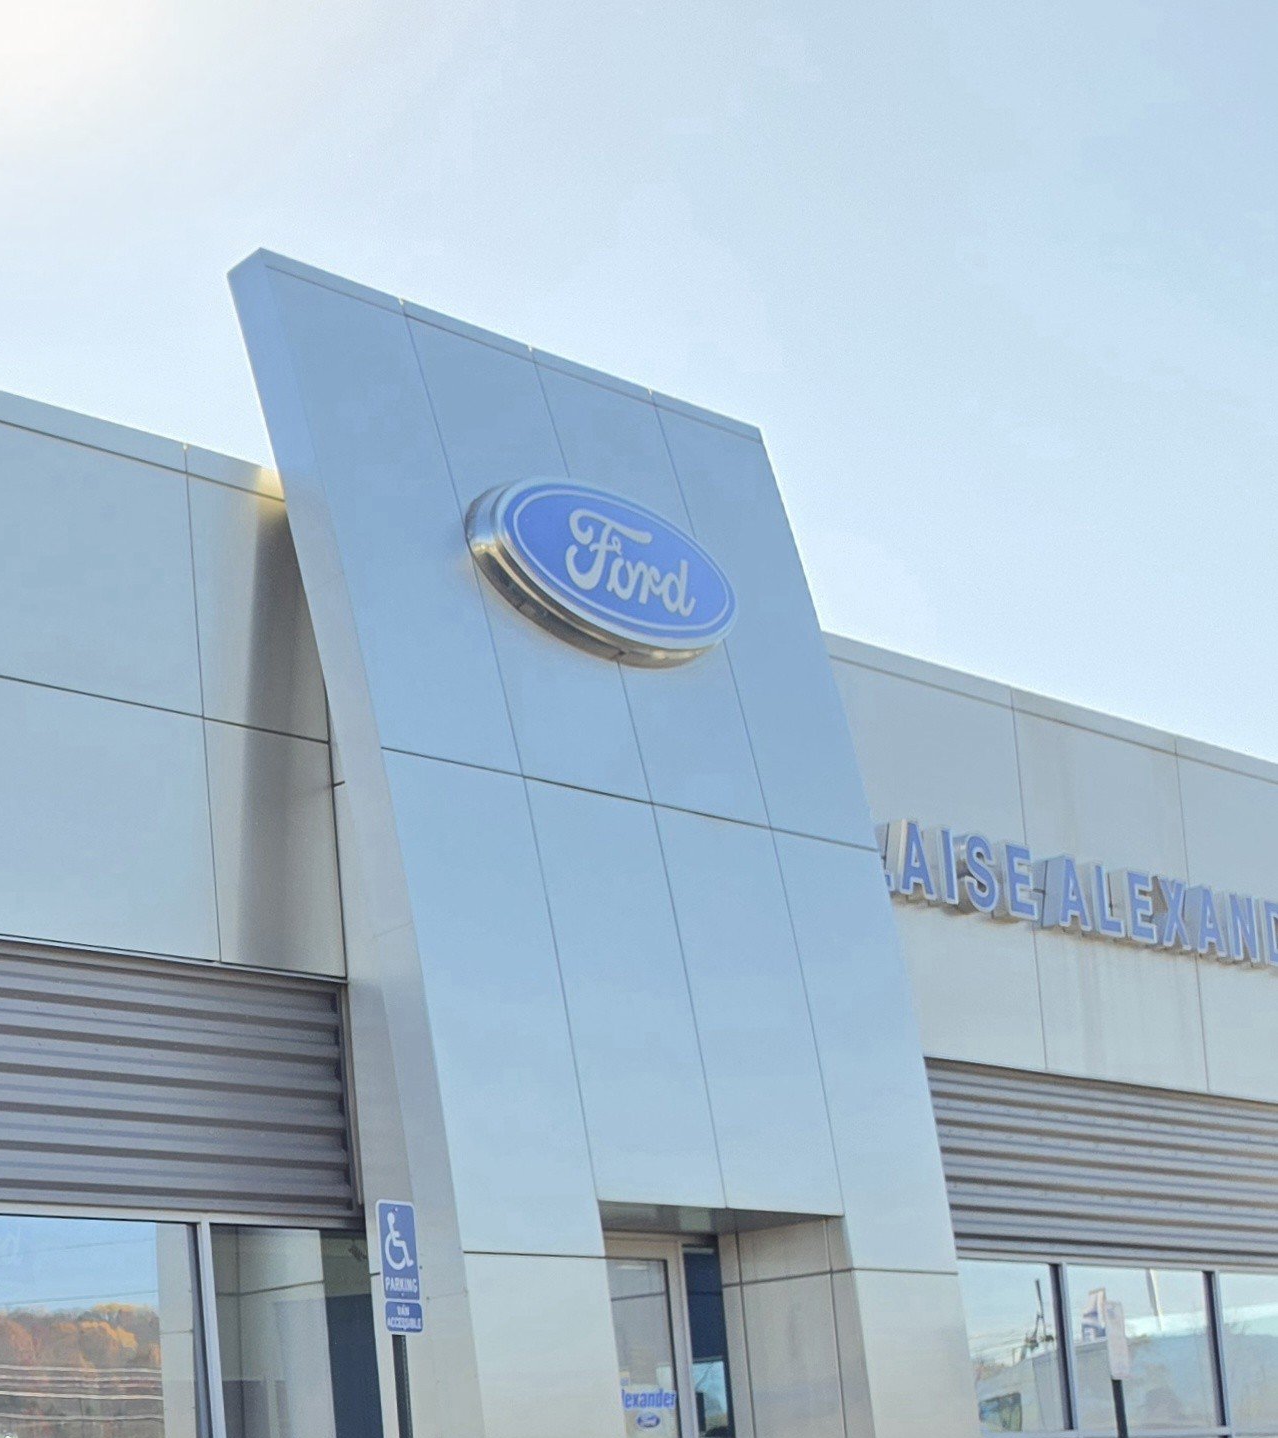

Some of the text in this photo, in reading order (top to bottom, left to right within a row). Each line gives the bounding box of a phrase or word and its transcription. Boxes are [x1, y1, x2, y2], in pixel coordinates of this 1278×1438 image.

[565, 509, 696, 617] Ford
[884, 820, 1040, 921] AISE
[385, 1276, 418, 1293] PARKING
[396, 1304, 410, 1316] VAN
